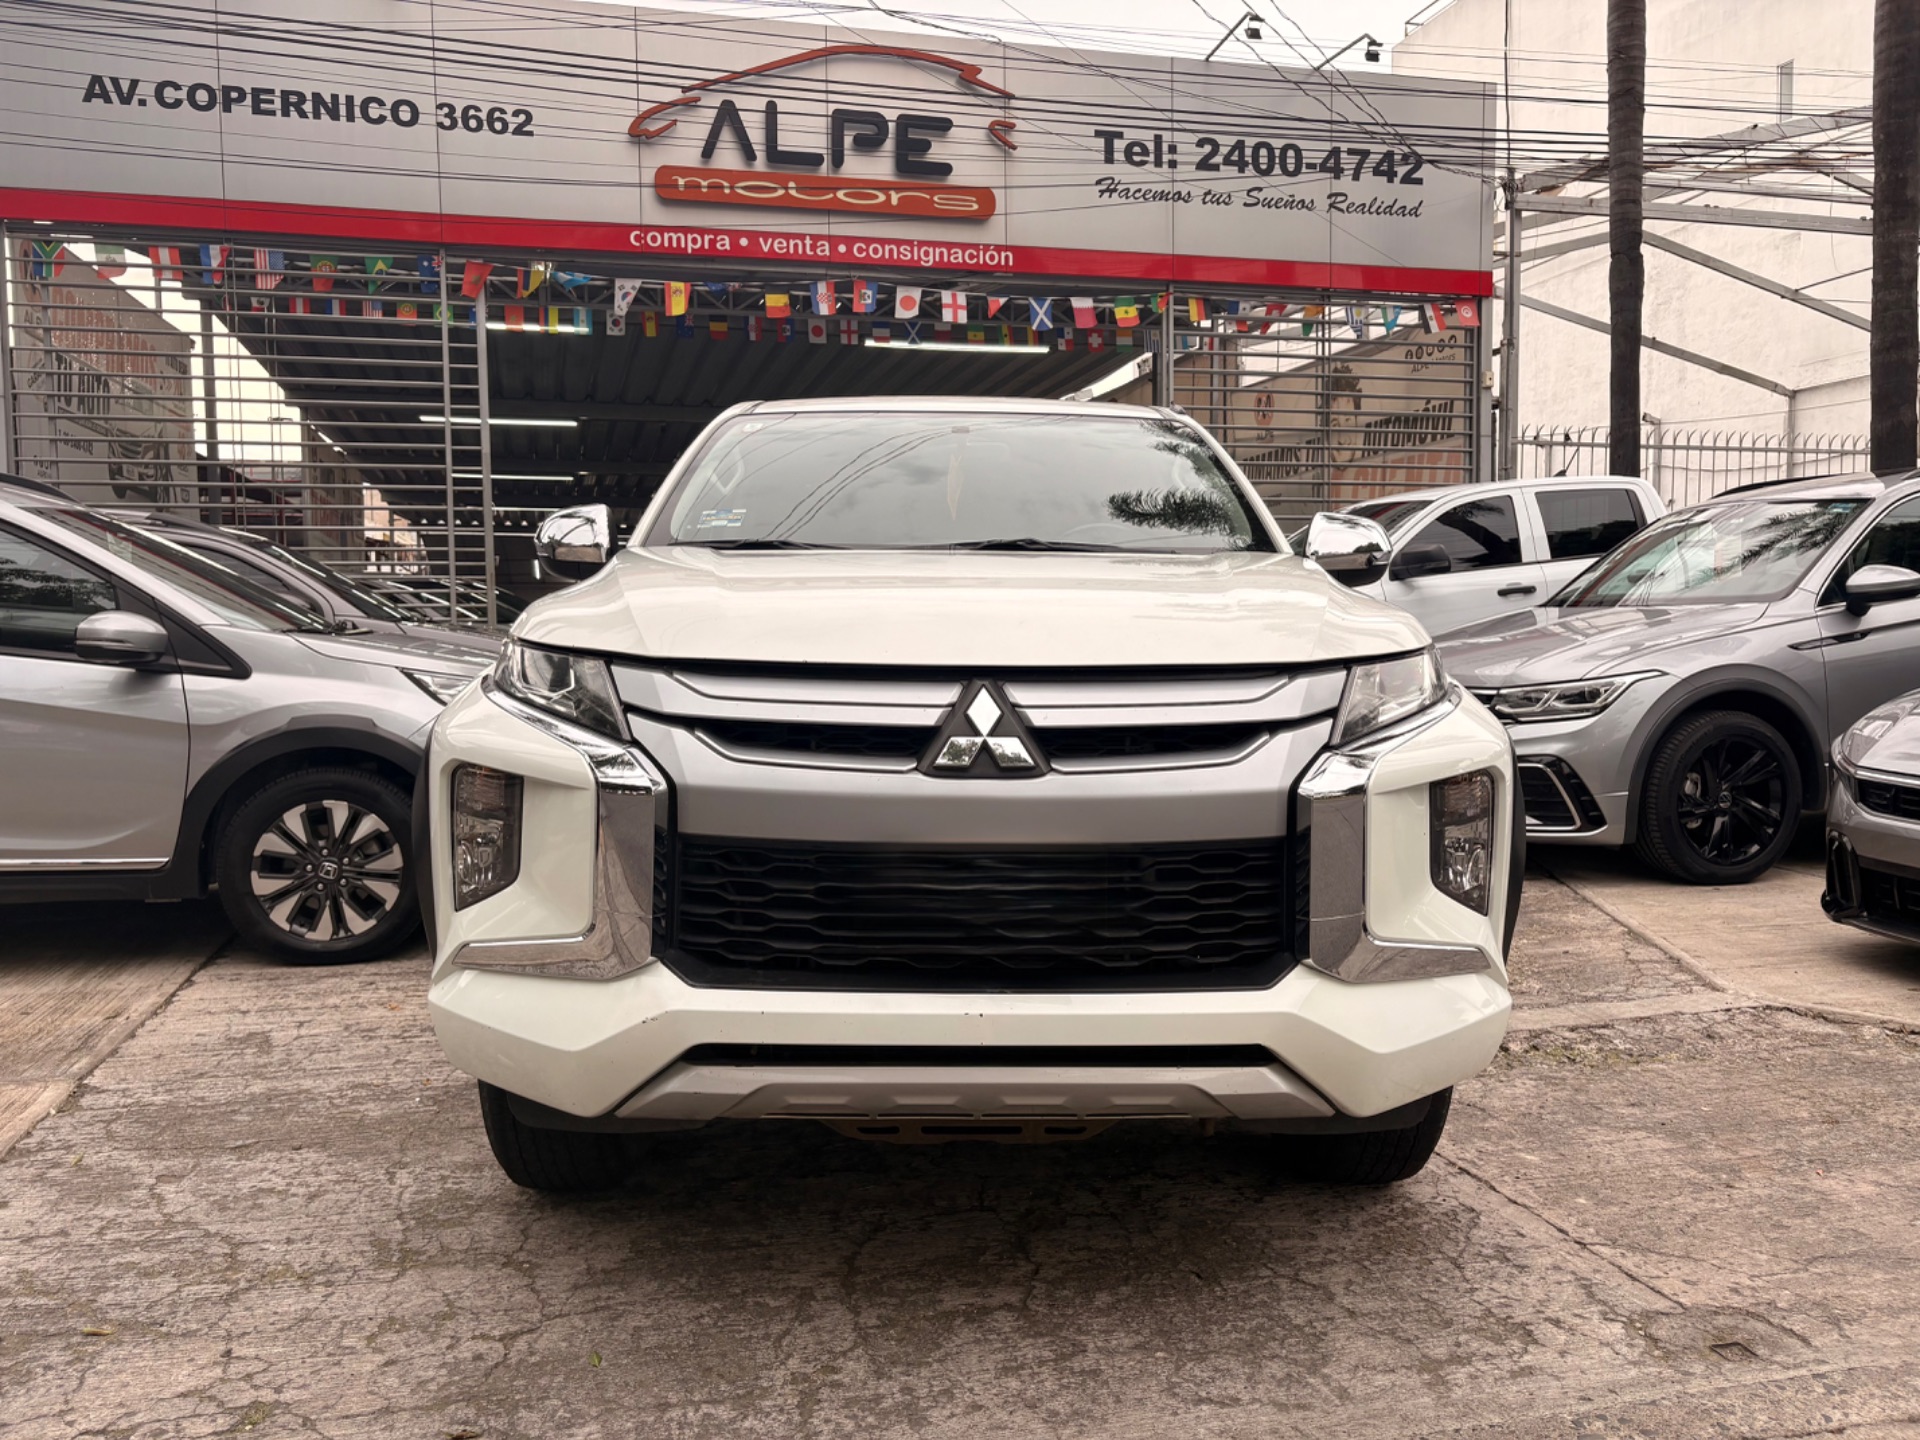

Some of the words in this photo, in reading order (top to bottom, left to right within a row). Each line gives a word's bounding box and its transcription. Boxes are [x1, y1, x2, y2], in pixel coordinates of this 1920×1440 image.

[82, 74, 420, 127] AV.COPERNICO
[435, 101, 535, 137] 3662
[701, 99, 953, 176] ALPE
[1094, 128, 1178, 169] Tel:
[1195, 136, 1425, 186] 2400-4742
[671, 175, 980, 212] motors
[1095, 176, 1193, 204] Hacemos
[1201, 189, 1233, 207] tus
[1242, 186, 1317, 212] Sueños
[1325, 192, 1423, 218] Realidad
[630, 229, 731, 254] compra
[759, 235, 830, 257] venta
[853, 239, 1014, 267] consignación
